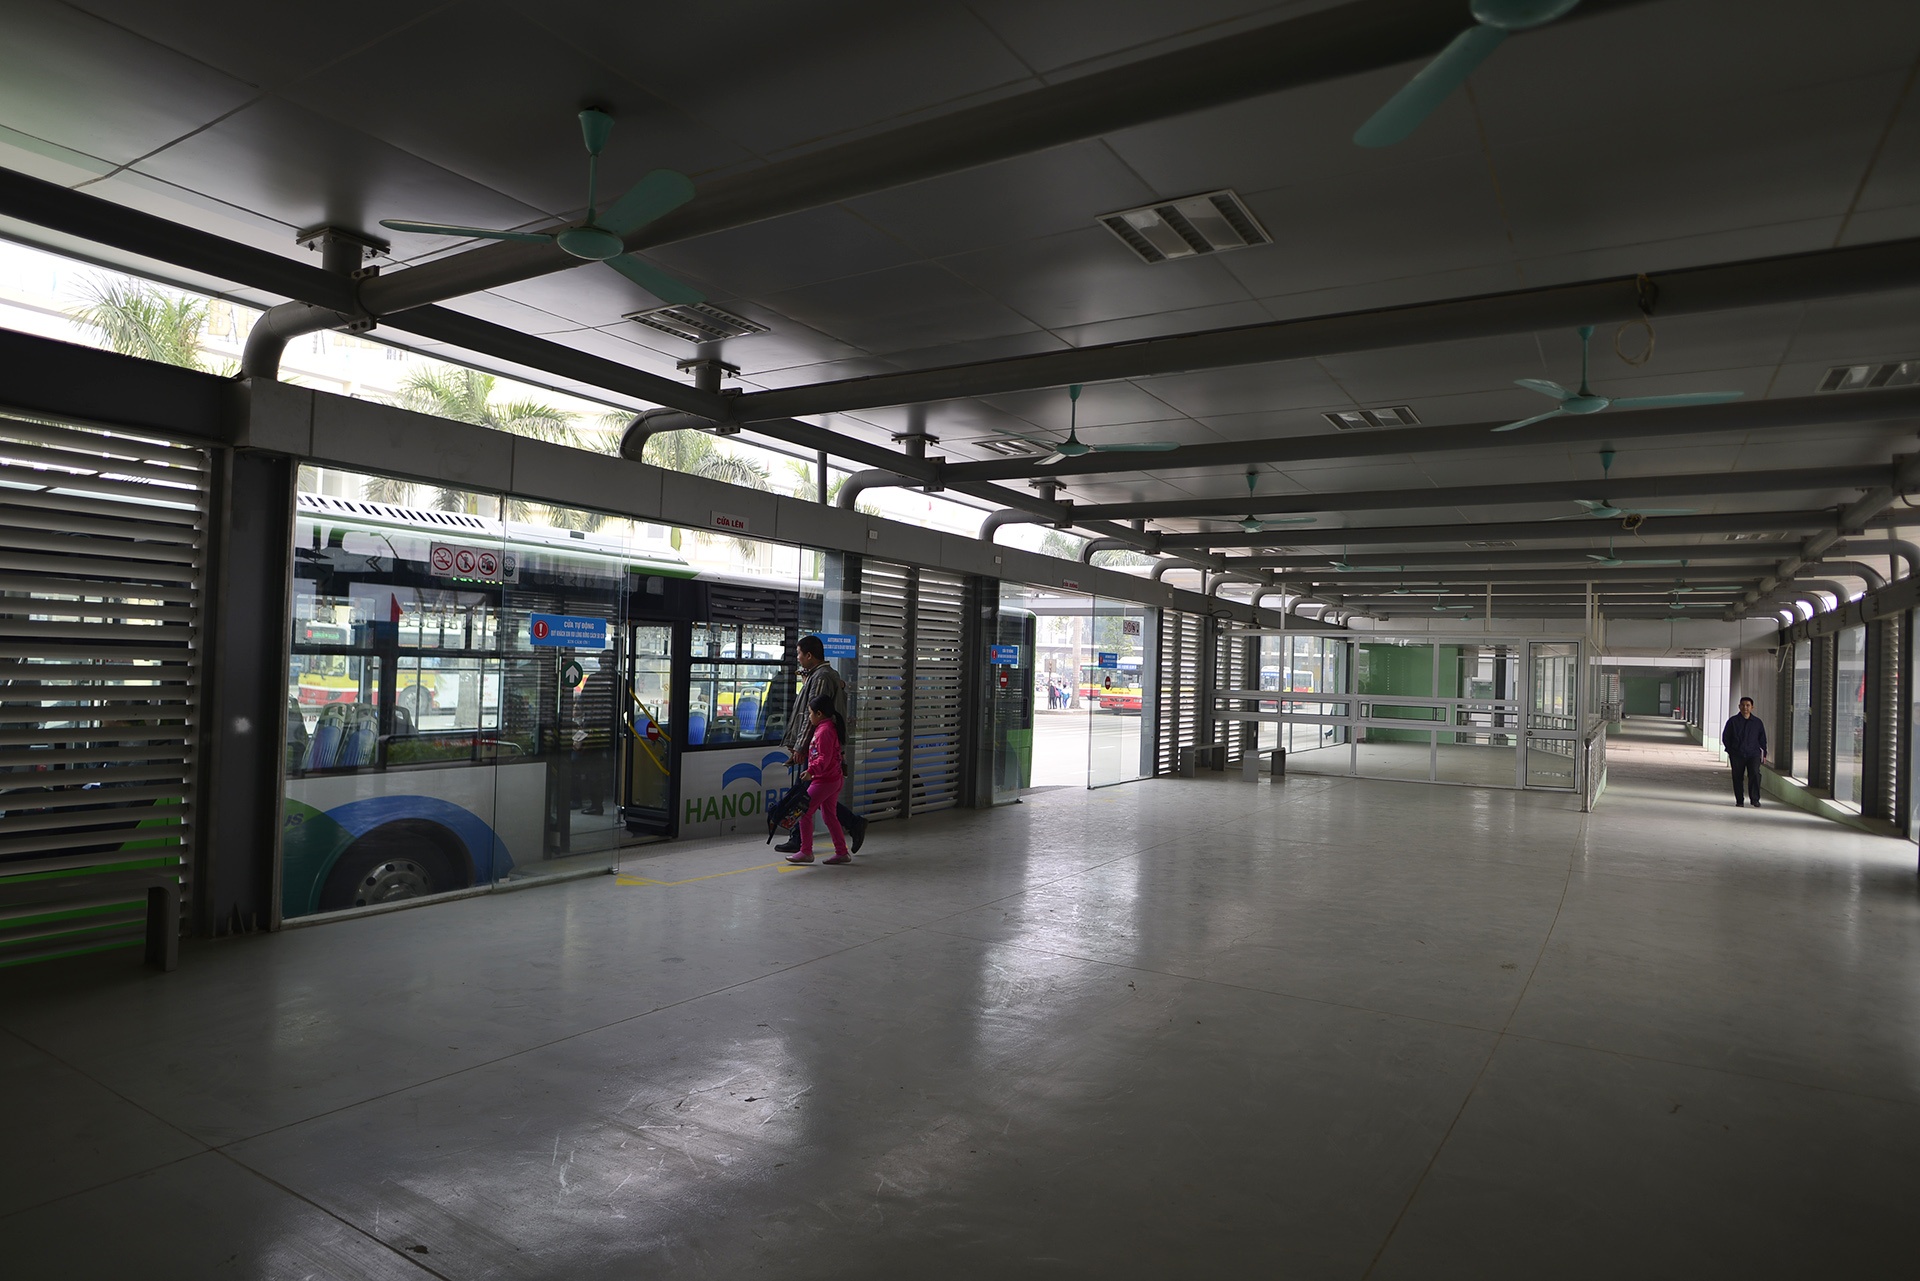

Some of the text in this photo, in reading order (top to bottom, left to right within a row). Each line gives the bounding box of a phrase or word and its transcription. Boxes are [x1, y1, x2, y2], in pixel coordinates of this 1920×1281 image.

[716, 516, 744, 528] CỬA LÊN
[685, 790, 760, 824] HANOI
